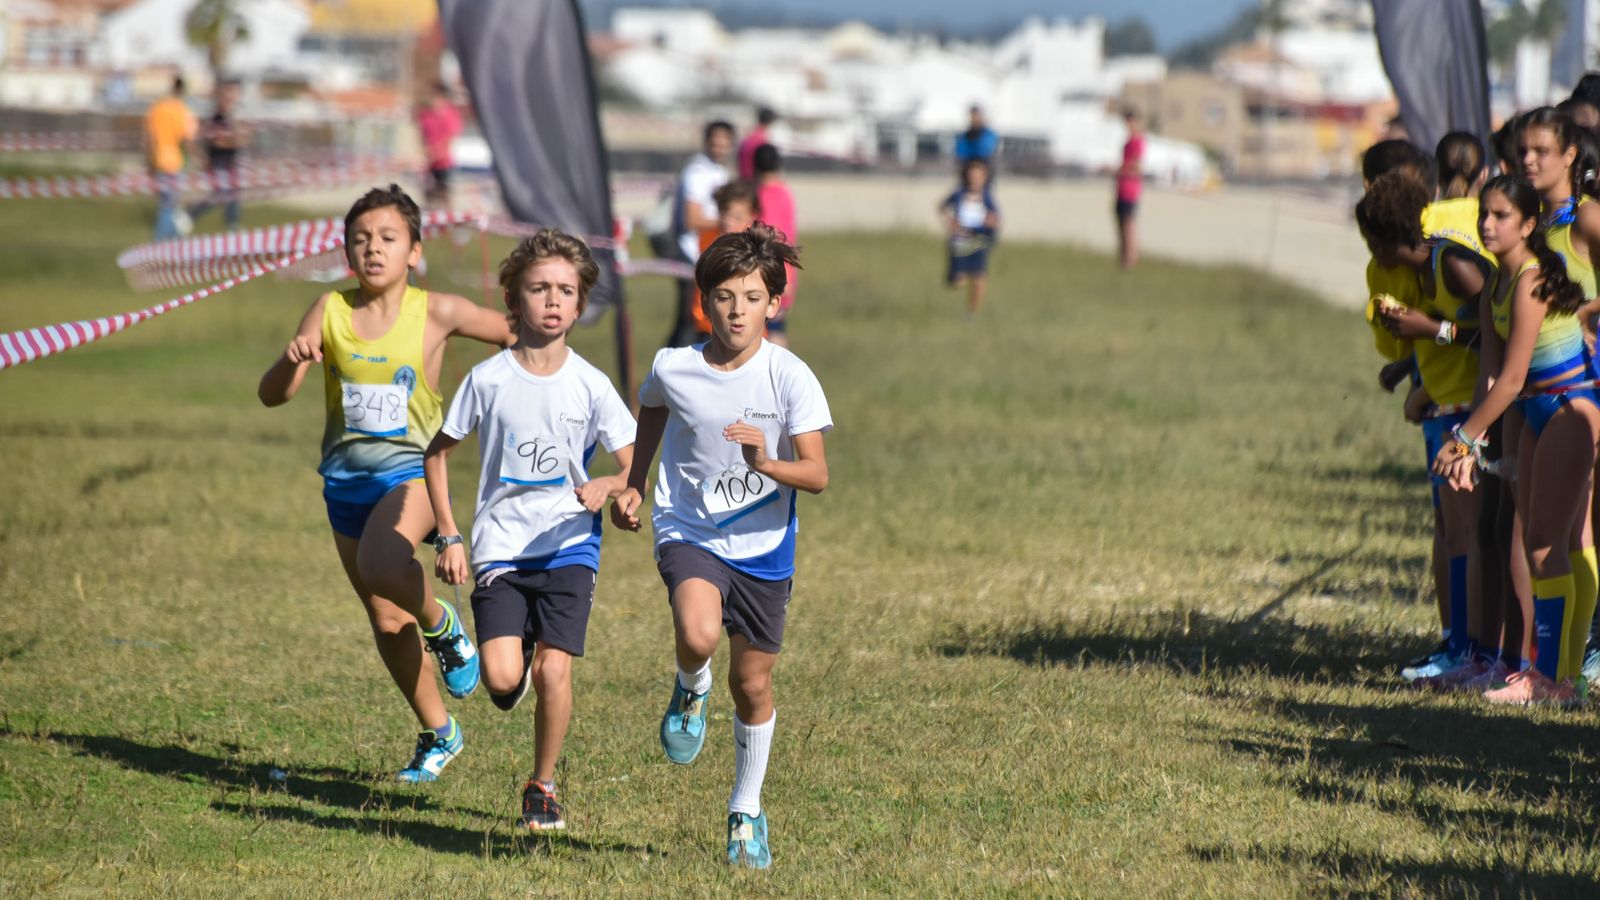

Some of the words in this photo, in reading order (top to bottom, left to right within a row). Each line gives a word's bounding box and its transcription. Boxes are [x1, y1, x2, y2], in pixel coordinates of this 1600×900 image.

[350, 391, 401, 423] 348
[518, 441, 558, 474] 96
[714, 470, 763, 508] 100
